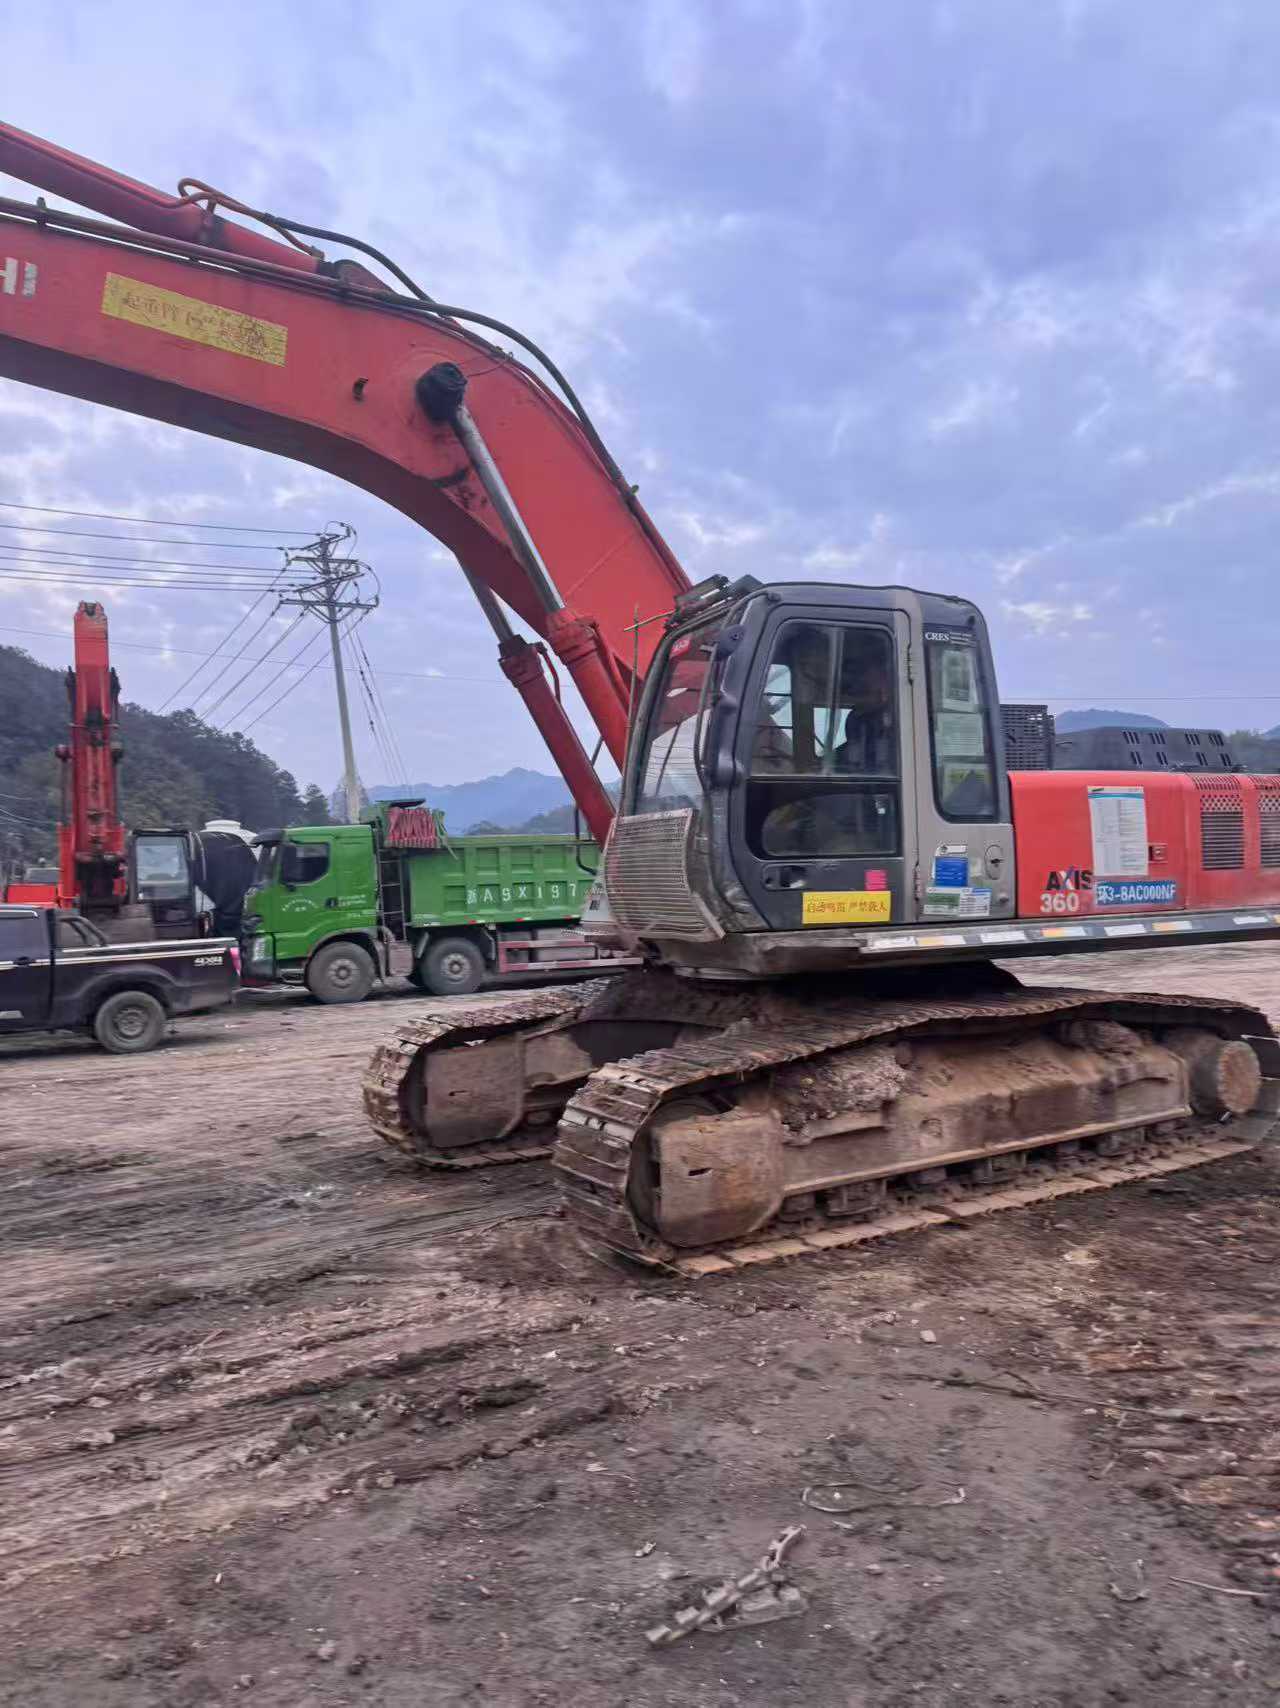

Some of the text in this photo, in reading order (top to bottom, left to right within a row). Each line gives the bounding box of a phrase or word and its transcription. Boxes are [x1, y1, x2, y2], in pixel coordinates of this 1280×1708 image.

[924, 631, 949, 642] CRES
[1046, 867, 1093, 891] AXIS
[1040, 892, 1080, 913] 360
